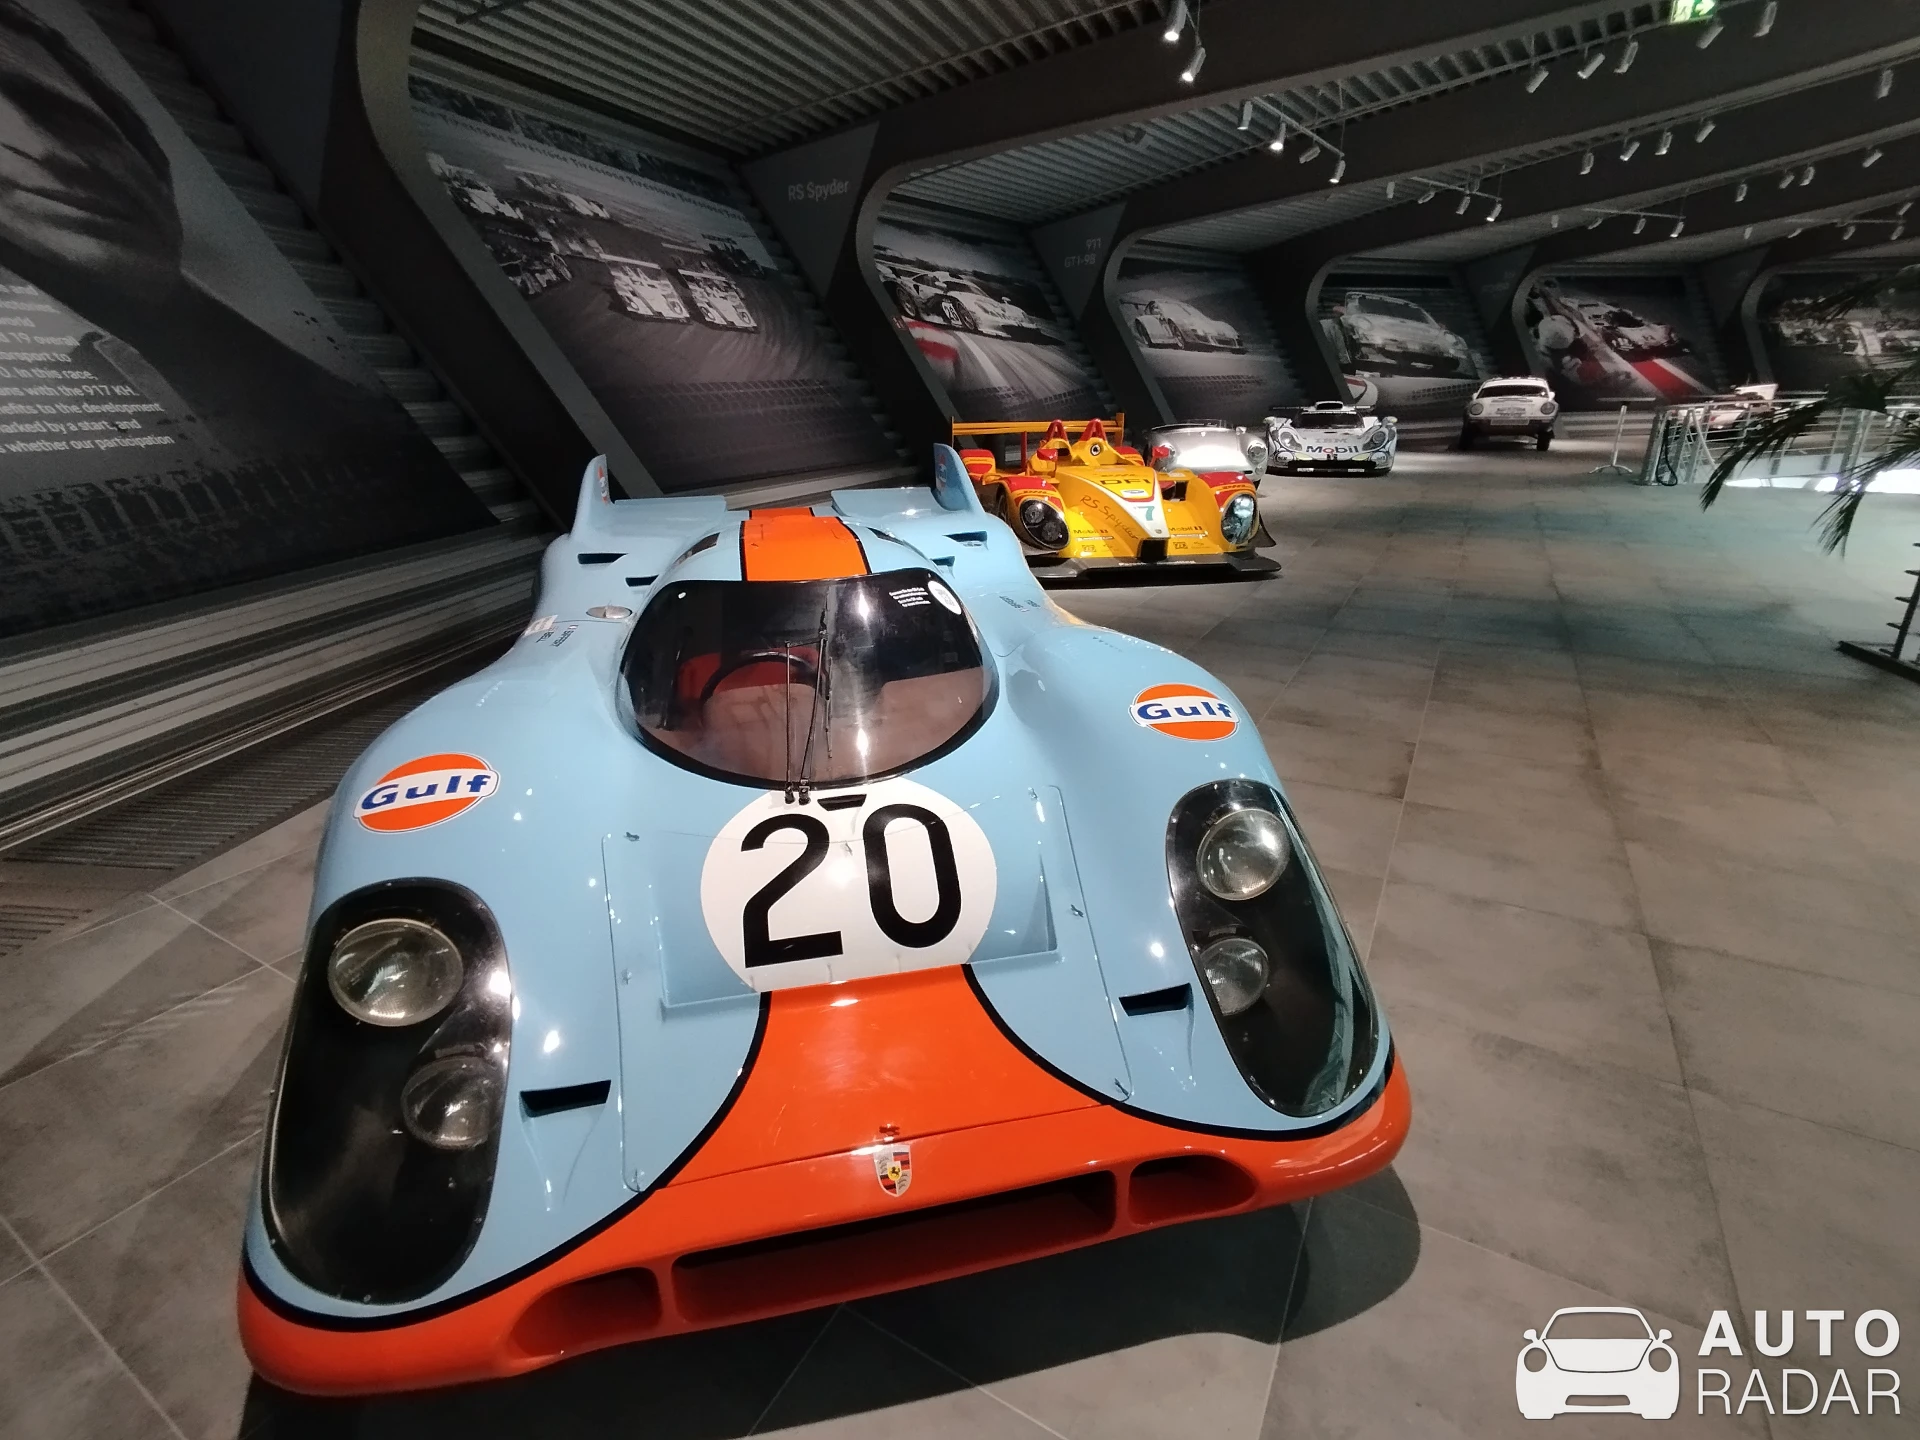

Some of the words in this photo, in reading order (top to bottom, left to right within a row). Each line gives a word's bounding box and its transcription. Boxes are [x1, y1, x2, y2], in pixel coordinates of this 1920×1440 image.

[788, 183, 804, 201] RS
[806, 178, 849, 202] Spyder
[33, 335, 81, 347] overall
[54, 352, 72, 363] to
[13, 366, 32, 378] In
[31, 366, 62, 379] this
[62, 369, 99, 381] race,
[23, 384, 60, 396] with
[57, 384, 84, 397] the
[81, 384, 111, 396] 917
[36, 403, 57, 415] to
[54, 402, 83, 415] the
[81, 401, 165, 415] development
[43, 419, 68, 435] by
[67, 421, 79, 432] a
[117, 417, 143, 432] and
[5, 439, 71, 454] whether
[69, 439, 95, 450] our
[94, 434, 176, 452] participation
[1306, 445, 1359, 454] Mobil
[1136, 505, 1156, 521] 7
[1136, 701, 1233, 721] Gulf
[361, 774, 492, 810] Gulf
[741, 803, 962, 969] 20
